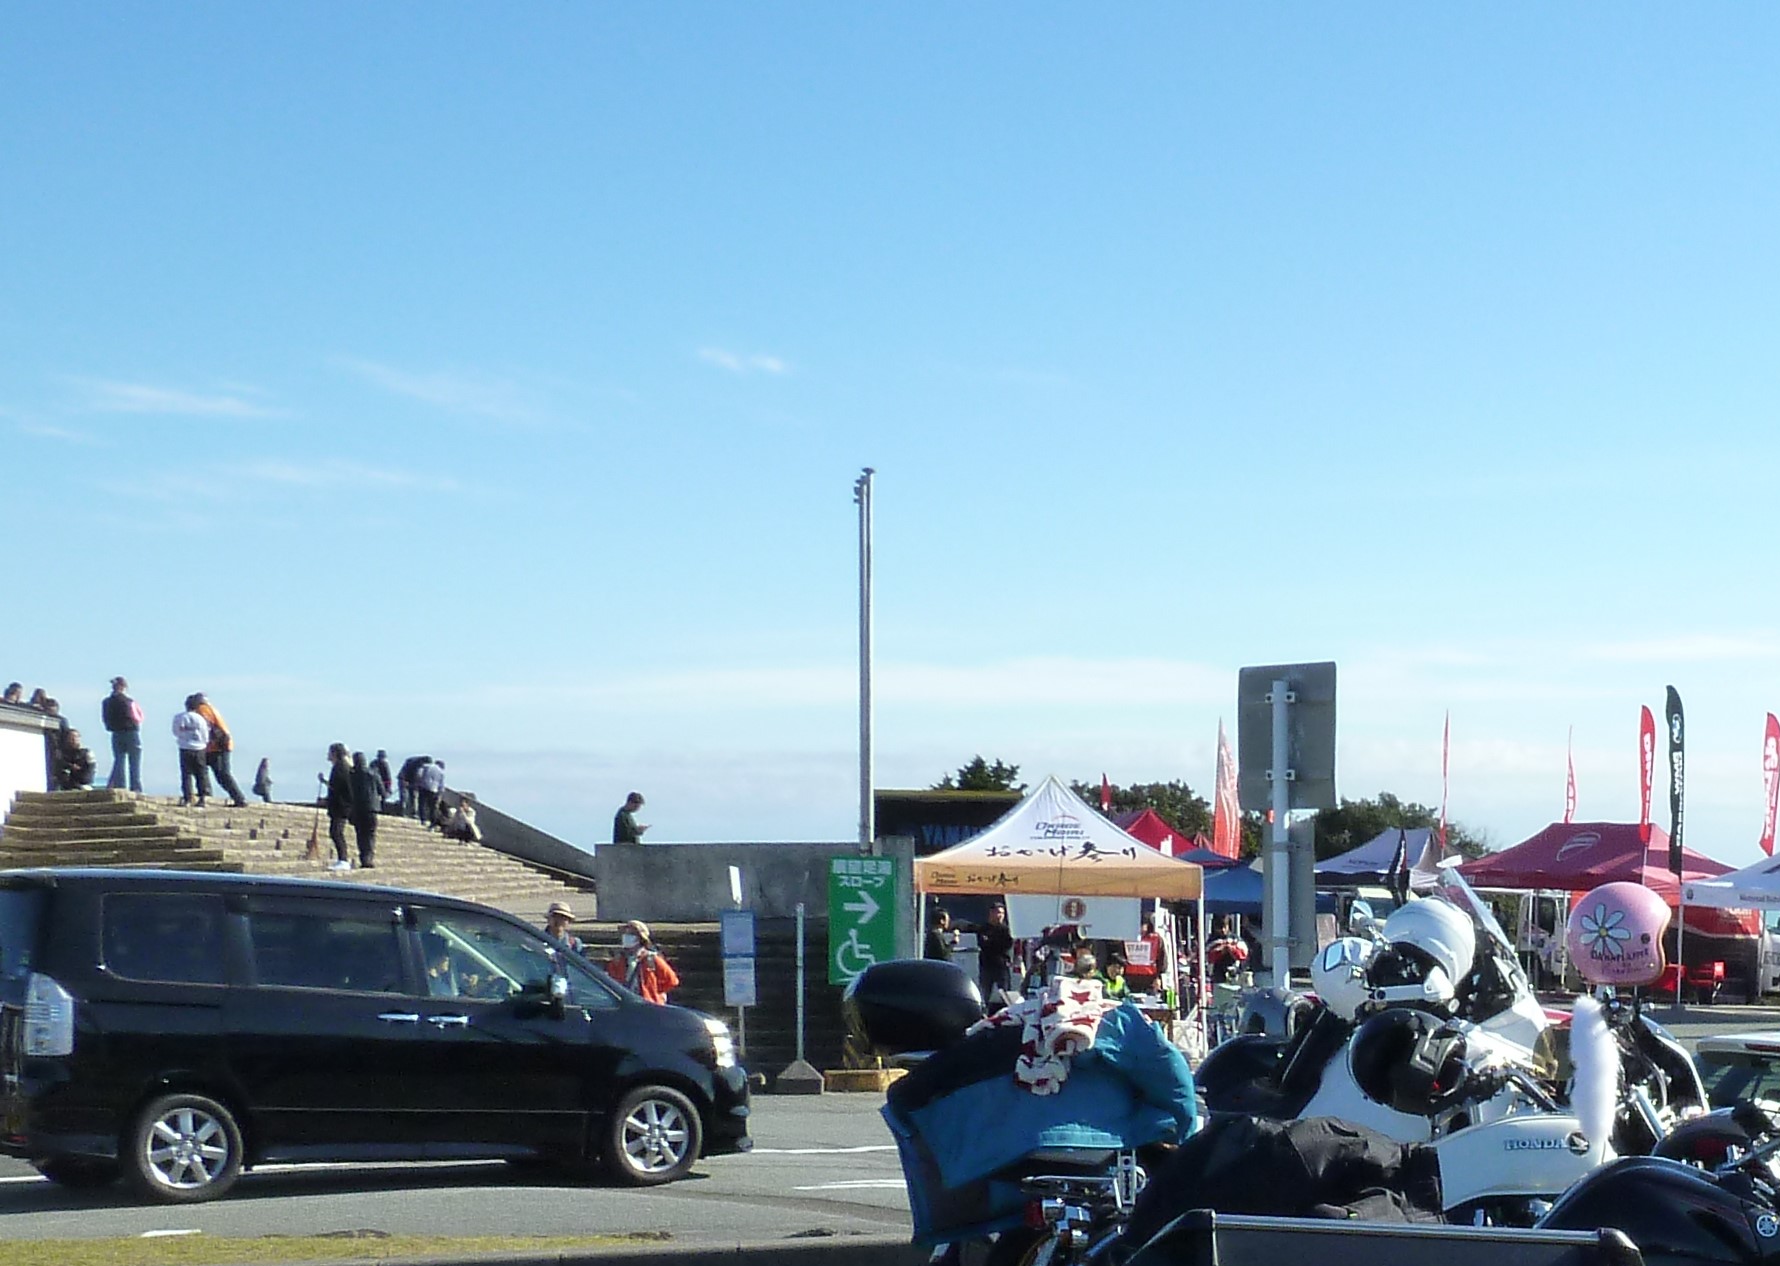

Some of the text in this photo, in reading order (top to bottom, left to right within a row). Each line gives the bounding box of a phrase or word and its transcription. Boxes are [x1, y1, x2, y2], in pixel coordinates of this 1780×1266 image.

[839, 875, 886, 888] スロープ
[1504, 1138, 1570, 1151] HONDA
